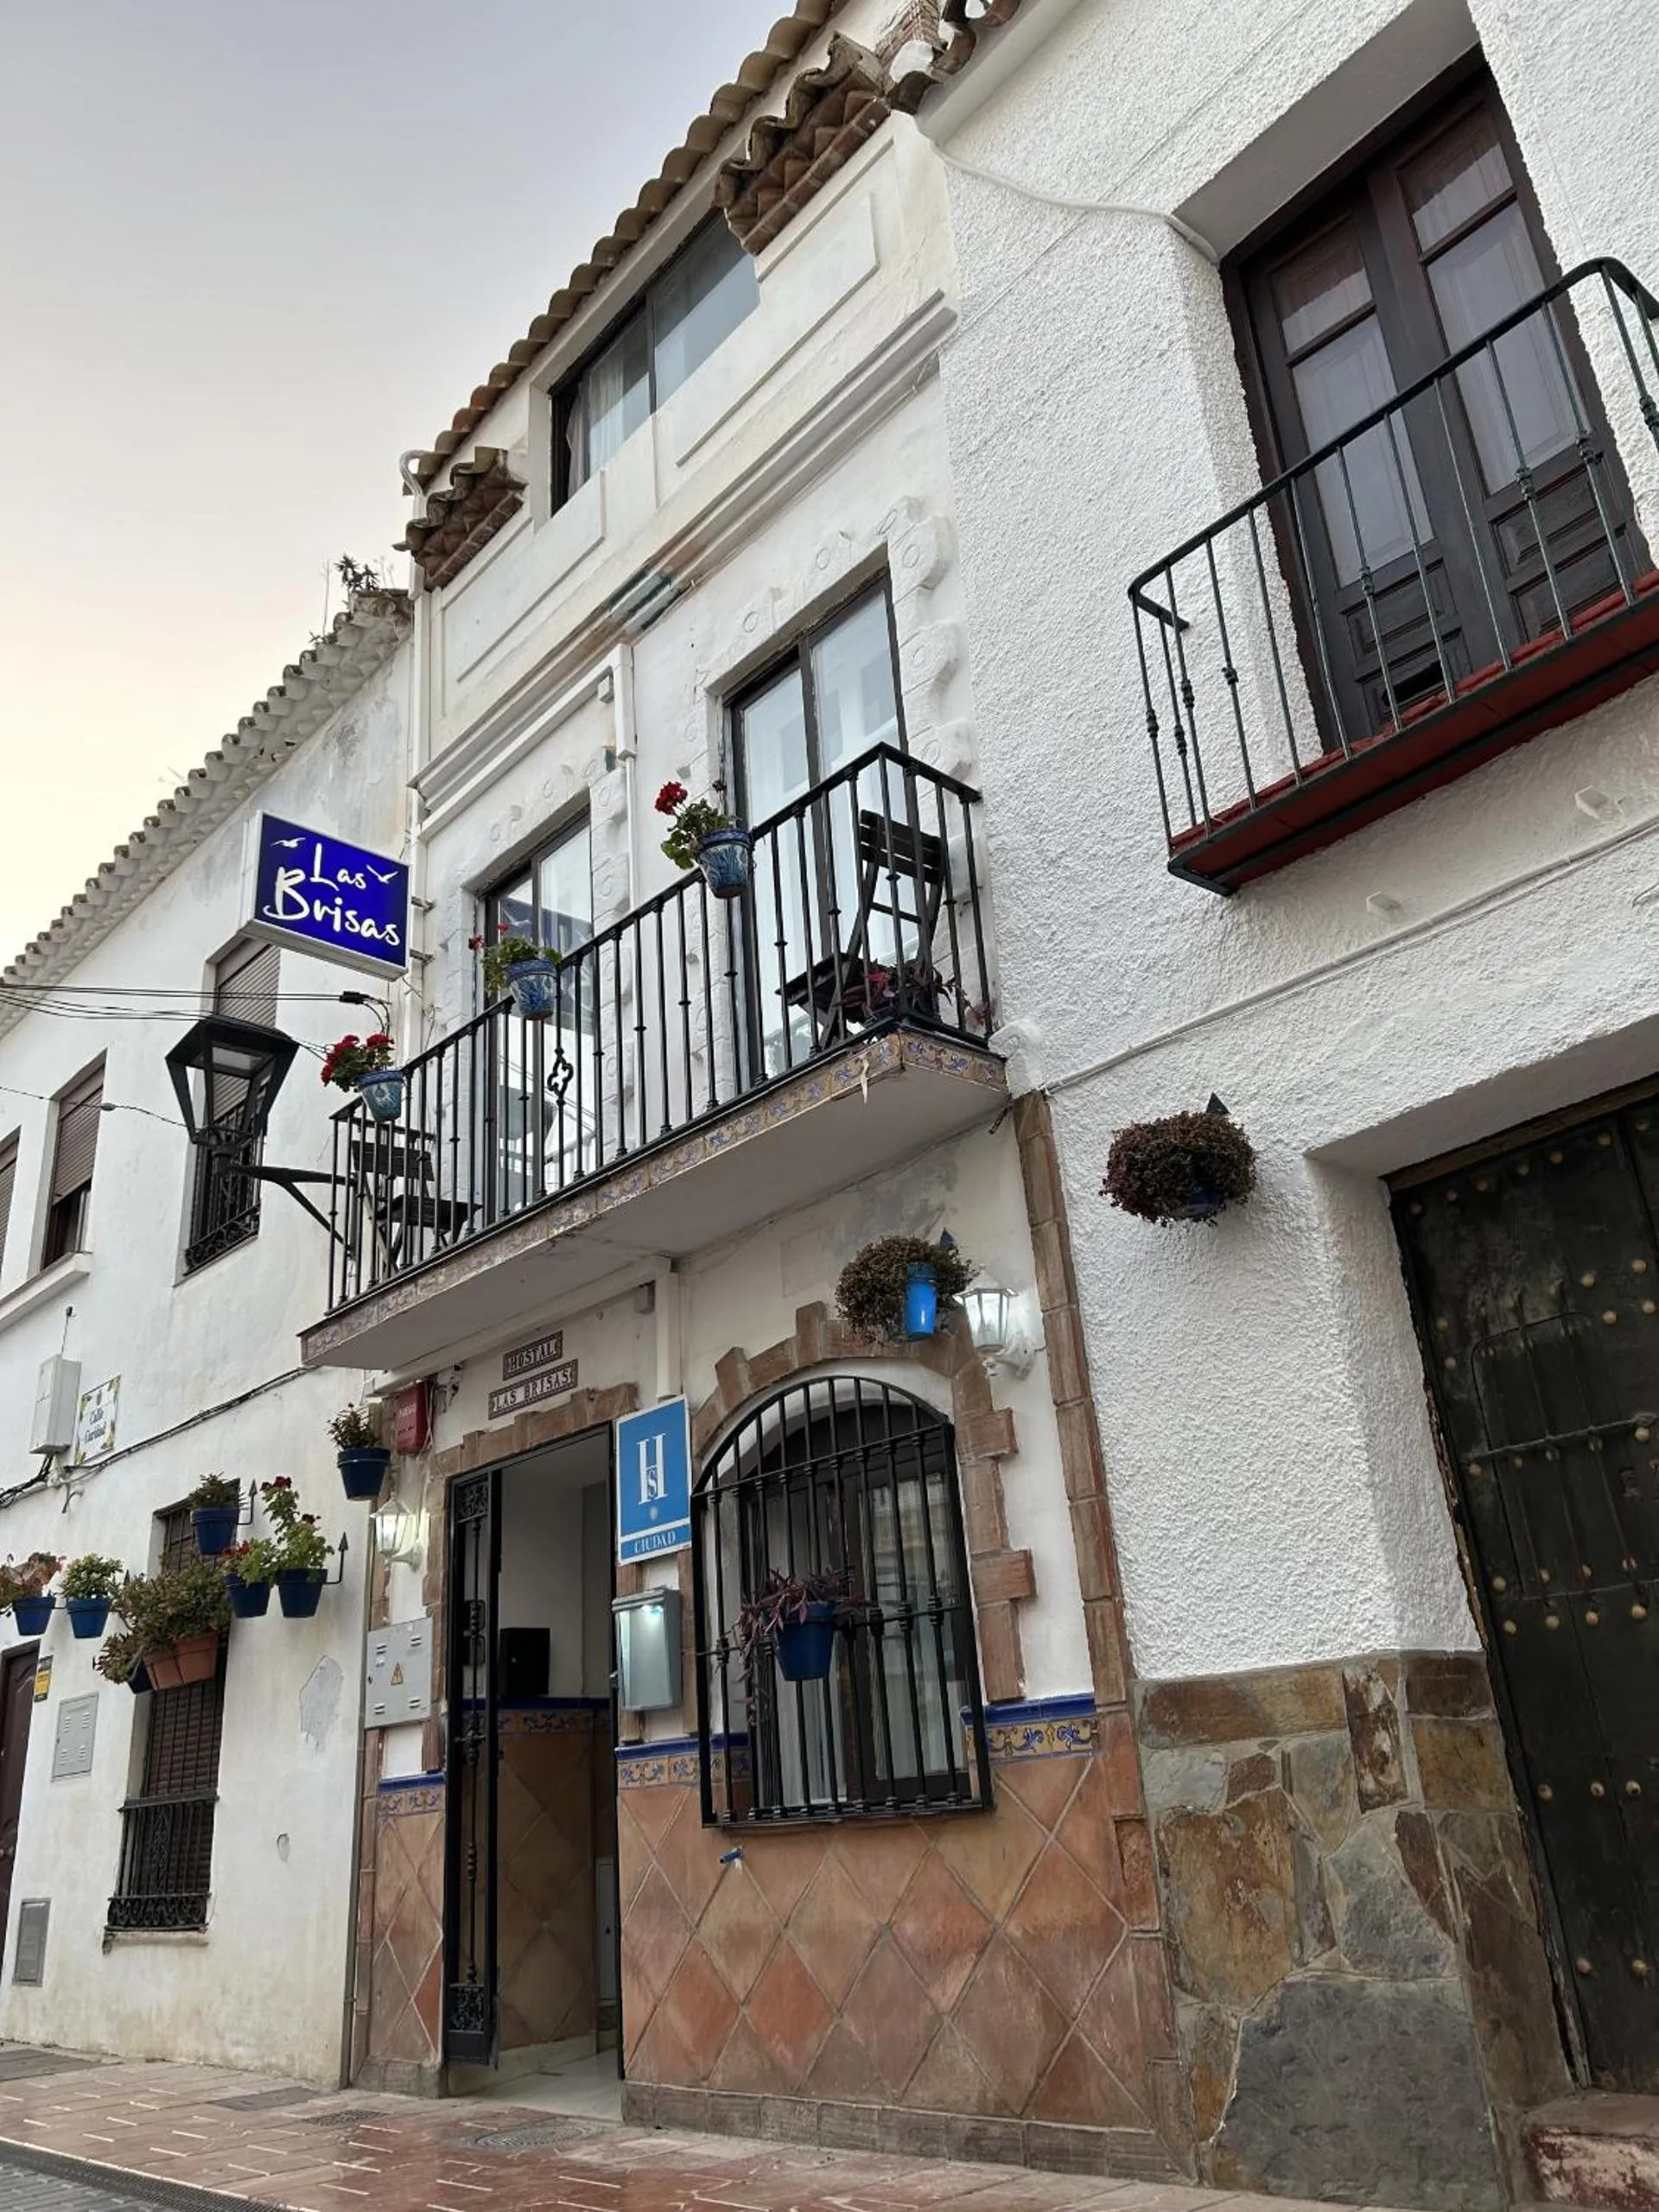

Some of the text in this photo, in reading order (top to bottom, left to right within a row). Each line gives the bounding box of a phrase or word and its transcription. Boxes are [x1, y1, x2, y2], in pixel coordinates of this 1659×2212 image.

[309, 842, 366, 891] Las
[263, 866, 400, 946] Brisas
[509, 1340, 556, 1370] HOSTAL
[494, 1369, 569, 1411] LAS BRISAS
[633, 1529, 677, 1554] CIUDAD
